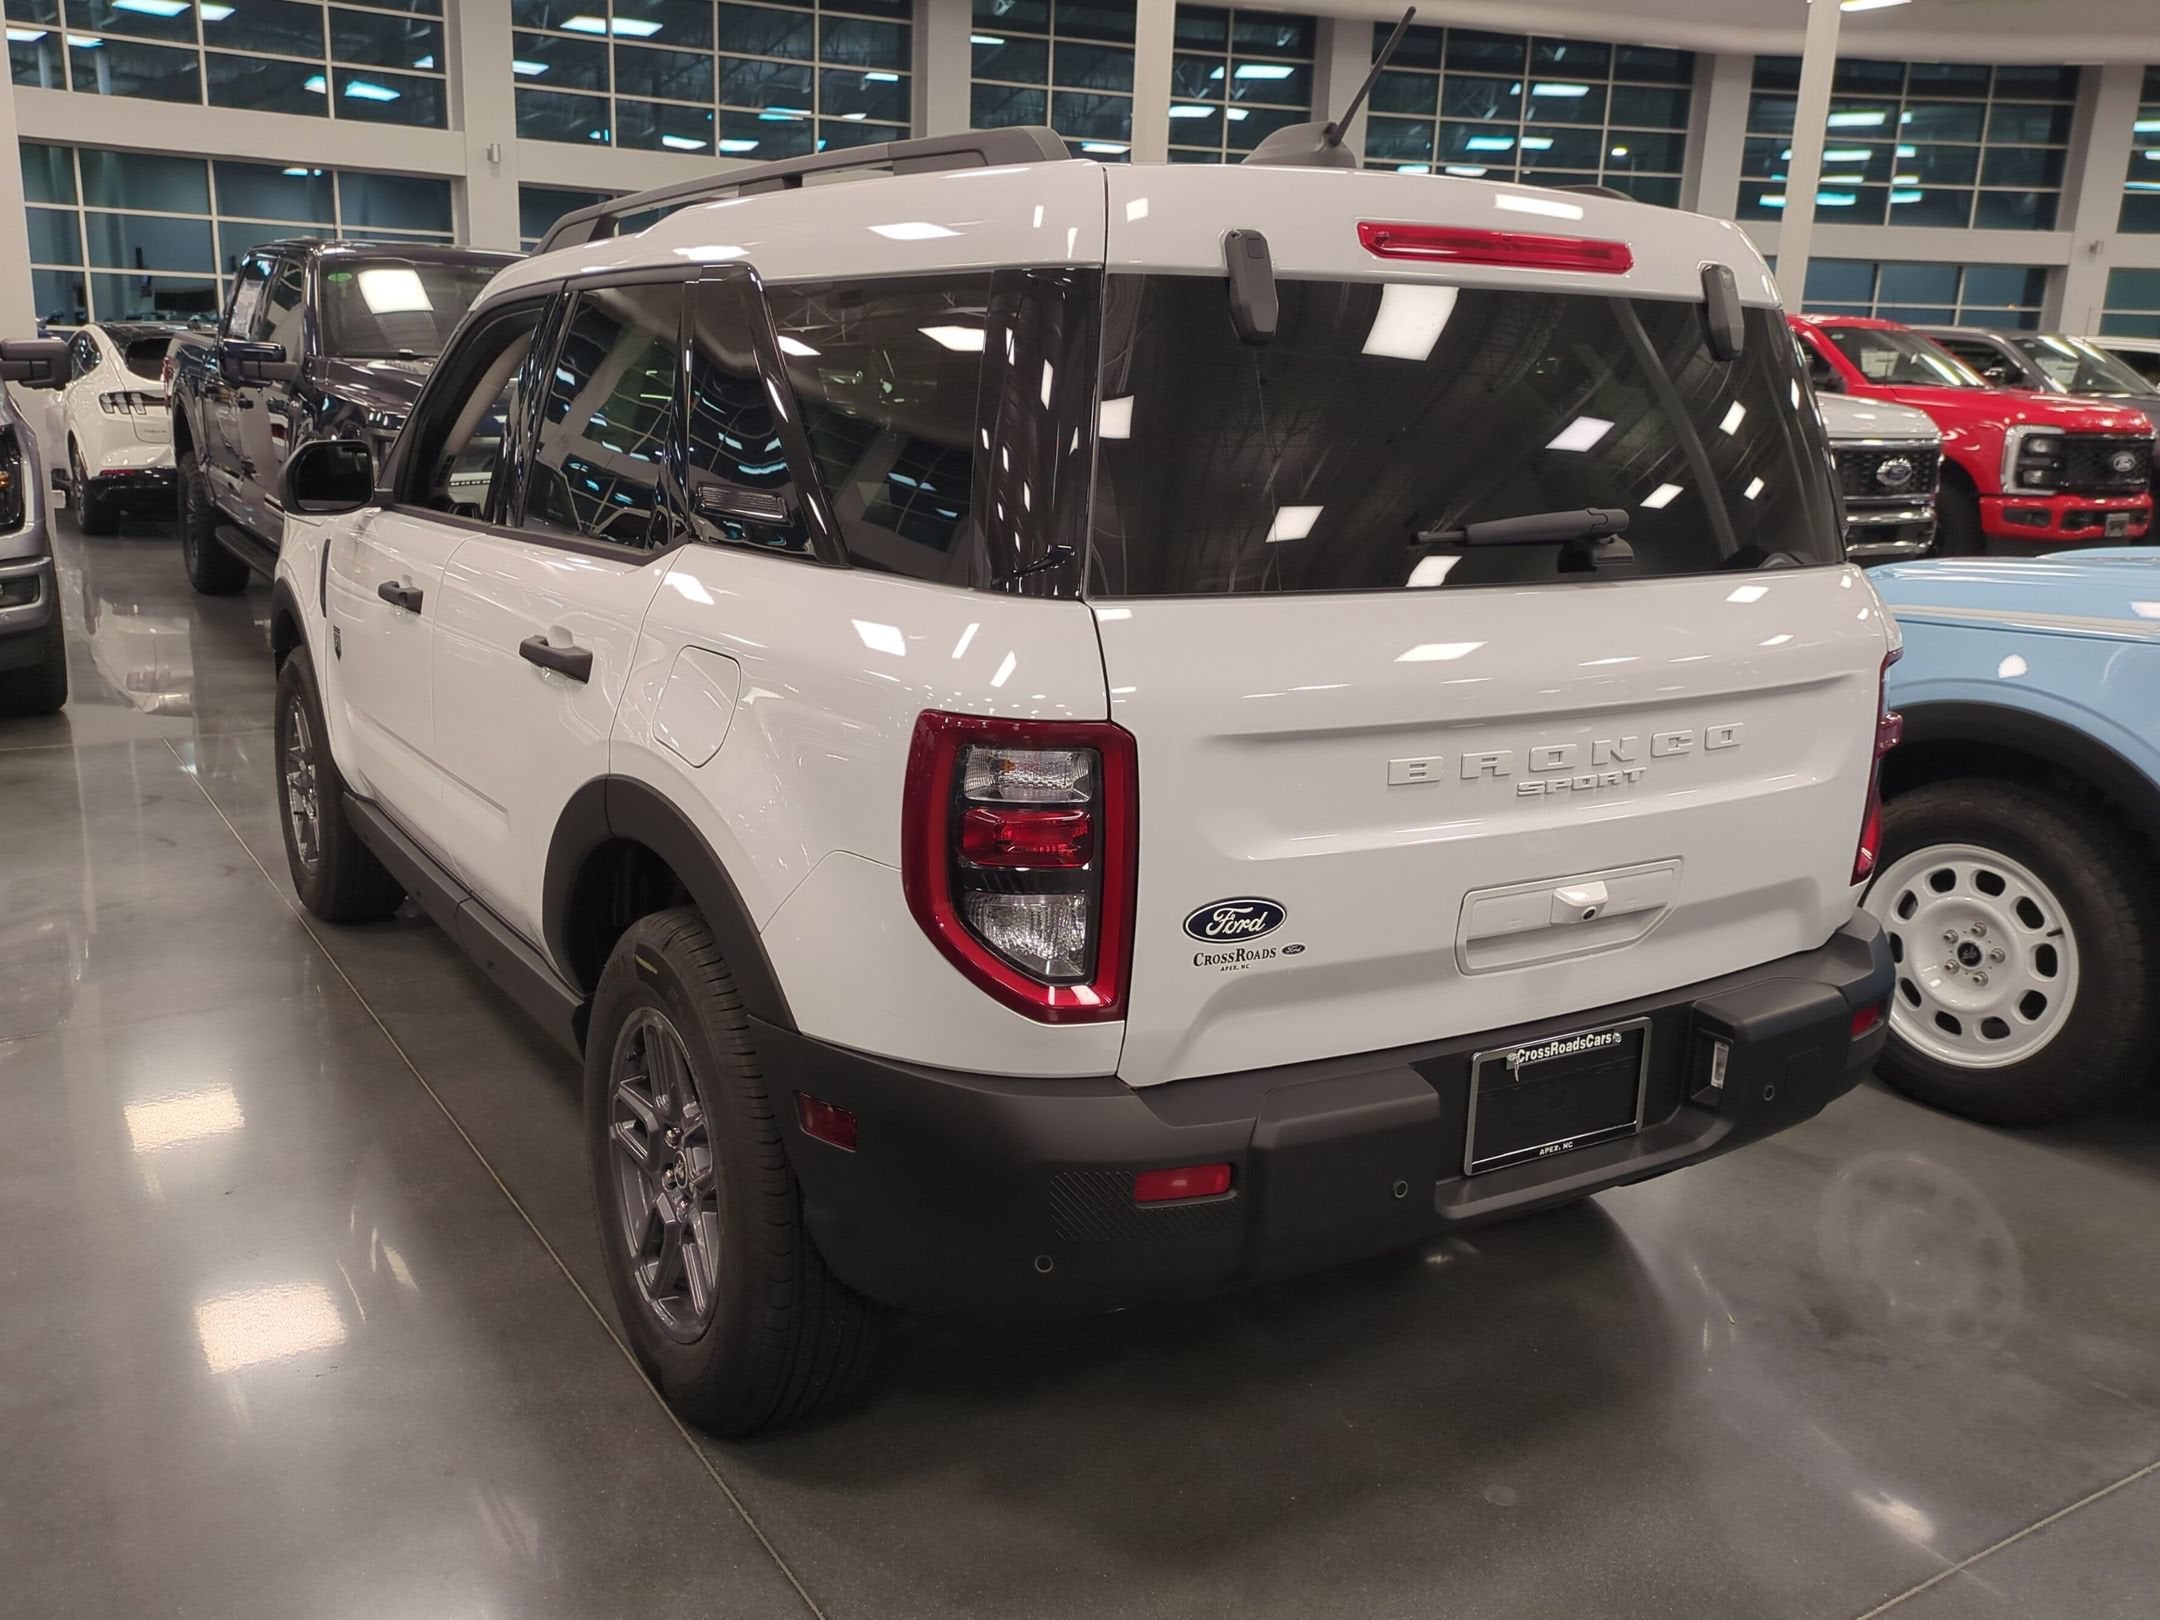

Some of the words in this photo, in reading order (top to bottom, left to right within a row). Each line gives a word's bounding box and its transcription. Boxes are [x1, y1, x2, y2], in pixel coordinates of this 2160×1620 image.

[1387, 723, 1743, 785] BRONCO
[1517, 767, 1647, 795] SPORT
[1206, 907, 1268, 935] Ford
[1517, 1033, 1612, 1063] CrossRoadsCars
[1539, 1145, 1561, 1155] APEX,
